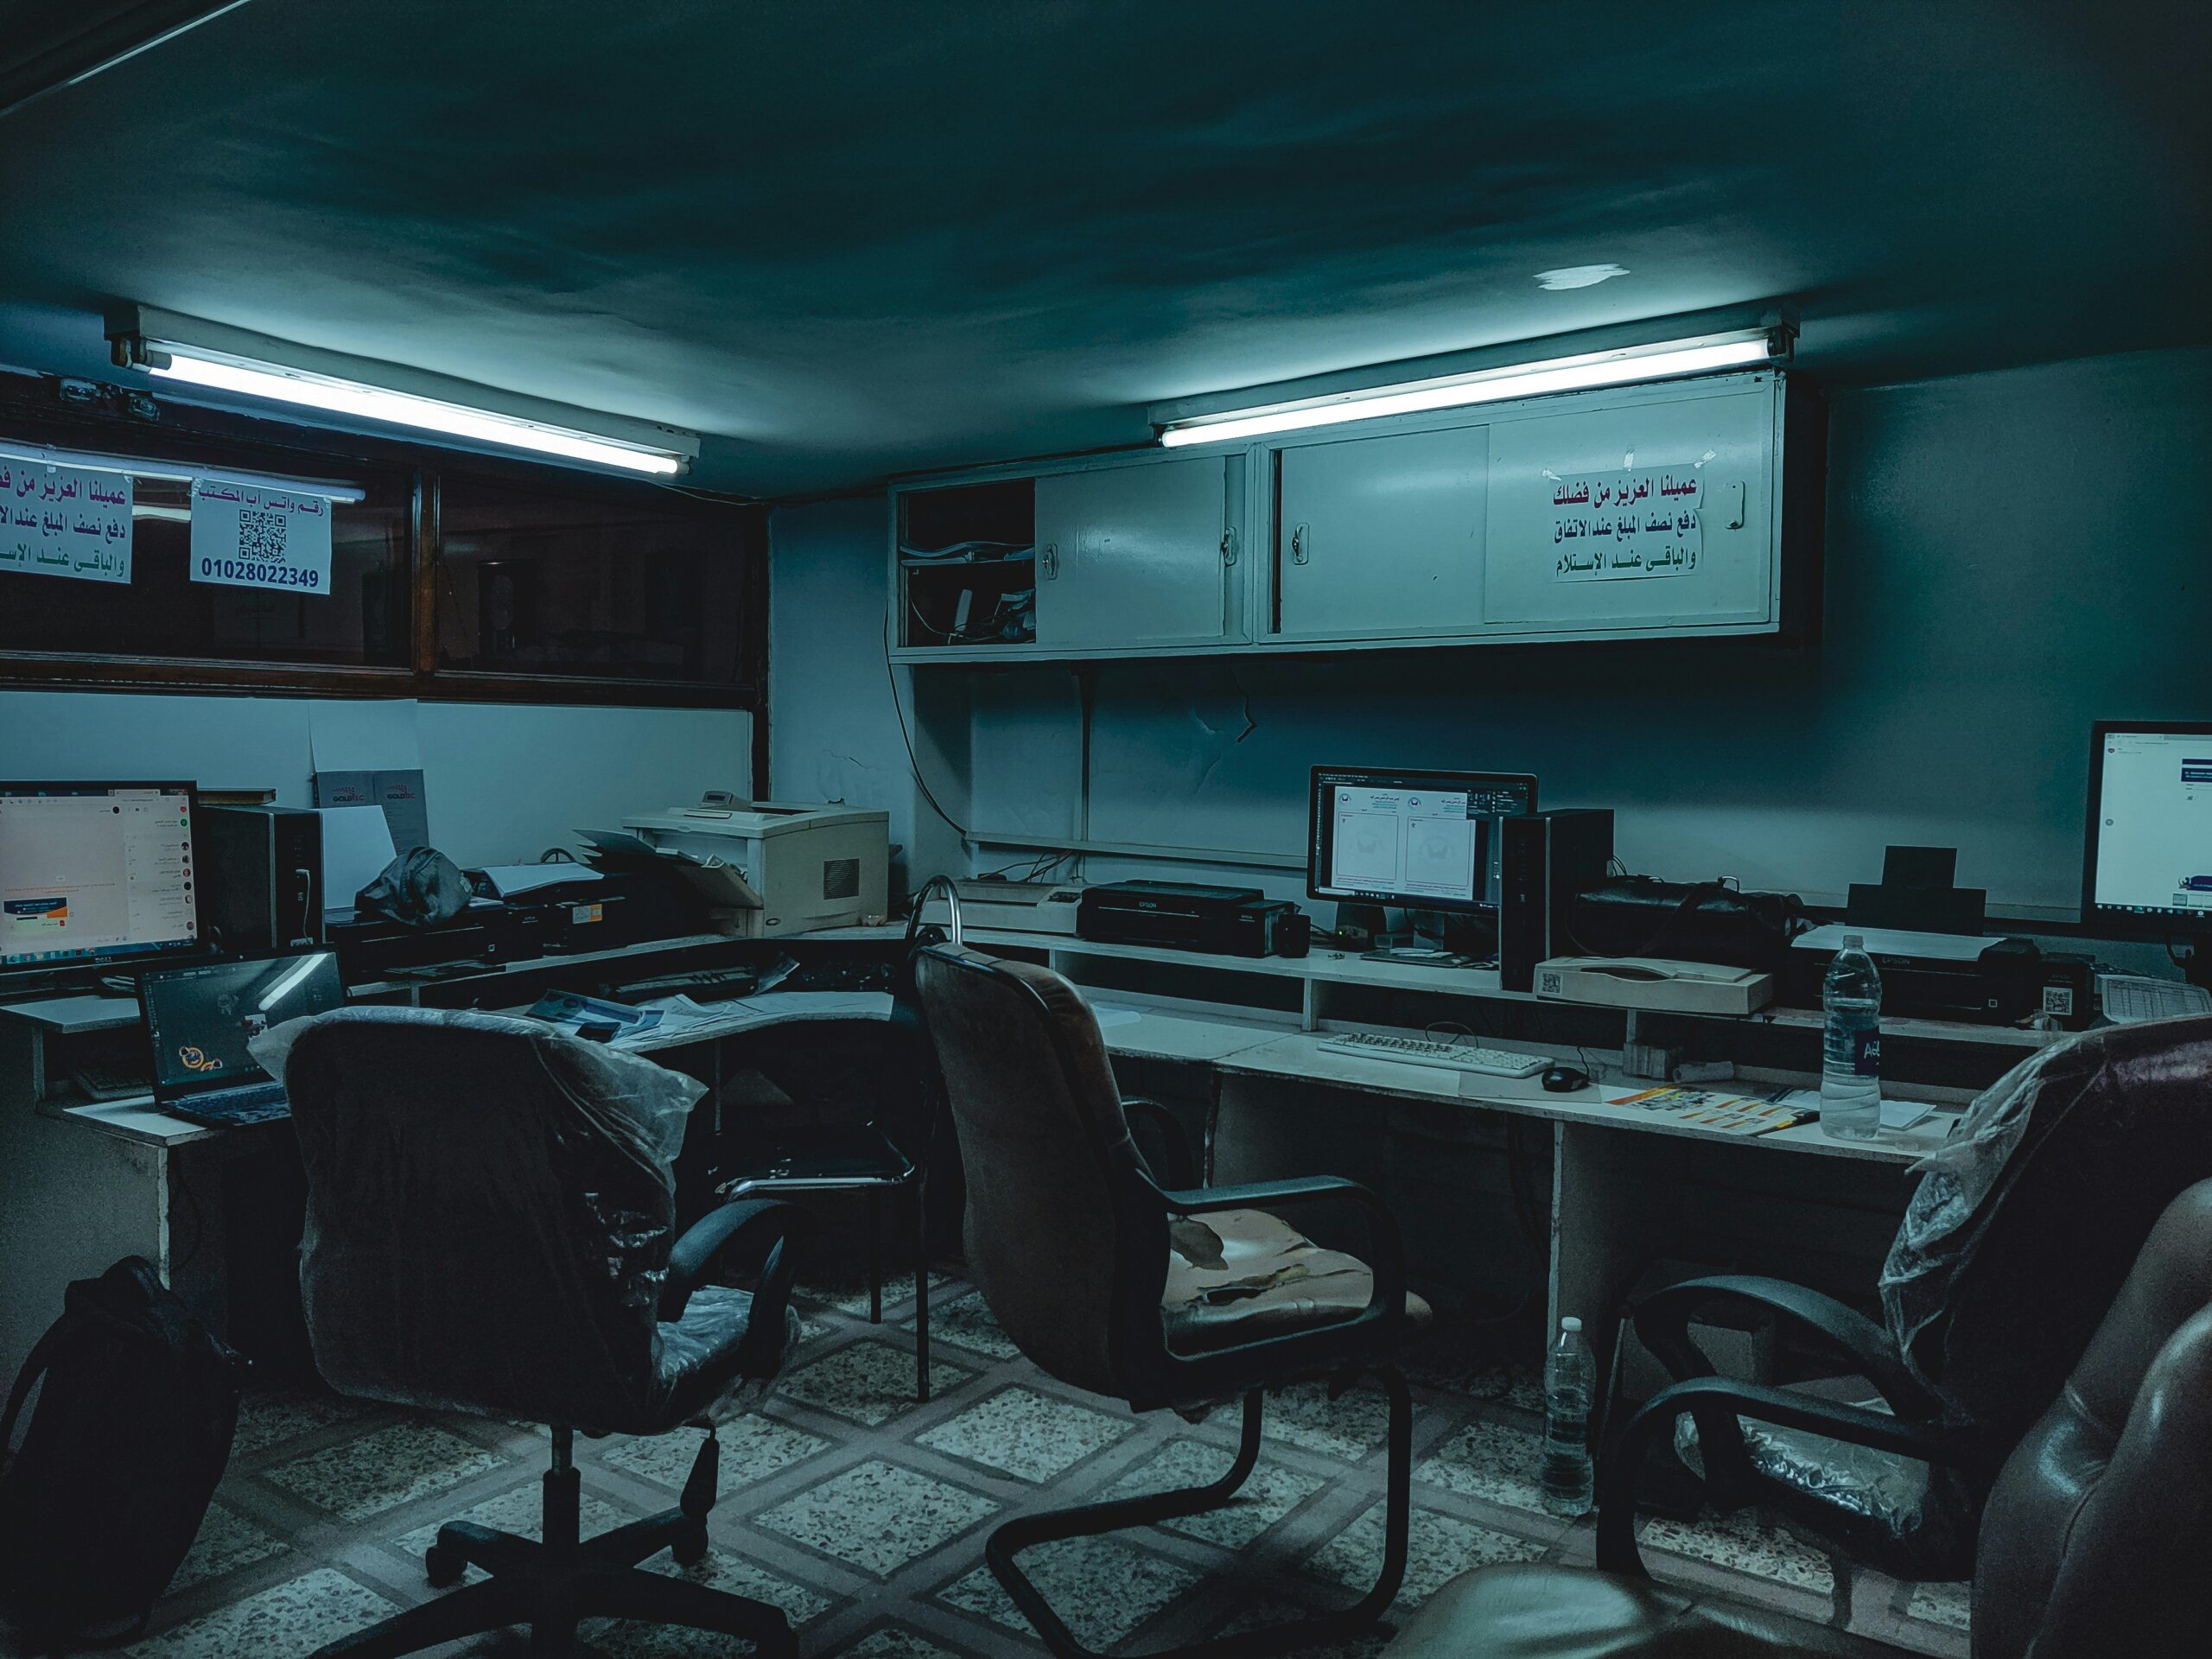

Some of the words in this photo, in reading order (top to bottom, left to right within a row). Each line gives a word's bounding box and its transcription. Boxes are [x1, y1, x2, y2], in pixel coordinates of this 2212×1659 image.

[16, 469, 35, 498] من
[38, 474, 82, 502] العزيز
[89, 480, 126, 508] عميلنا
[198, 485, 244, 502] المكتب
[1553, 480, 1589, 505] فضلك
[1594, 481, 1611, 508] من
[1613, 477, 1654, 506] العزيز
[1660, 474, 1697, 501] عميلنا
[264, 496, 295, 513] واتس
[297, 499, 324, 517] رقم
[41, 511, 67, 537] المبلغ
[73, 513, 102, 536] نصف
[105, 518, 125, 544] دفع
[1617, 514, 1640, 542] المبلغ
[1645, 512, 1673, 532] نصف
[1676, 510, 1696, 537] دفع
[37, 546, 69, 566] عند
[1611, 550, 1642, 569] عند
[201, 557, 319, 588] 01028022349
[333, 794, 364, 803] GOLDTEC
